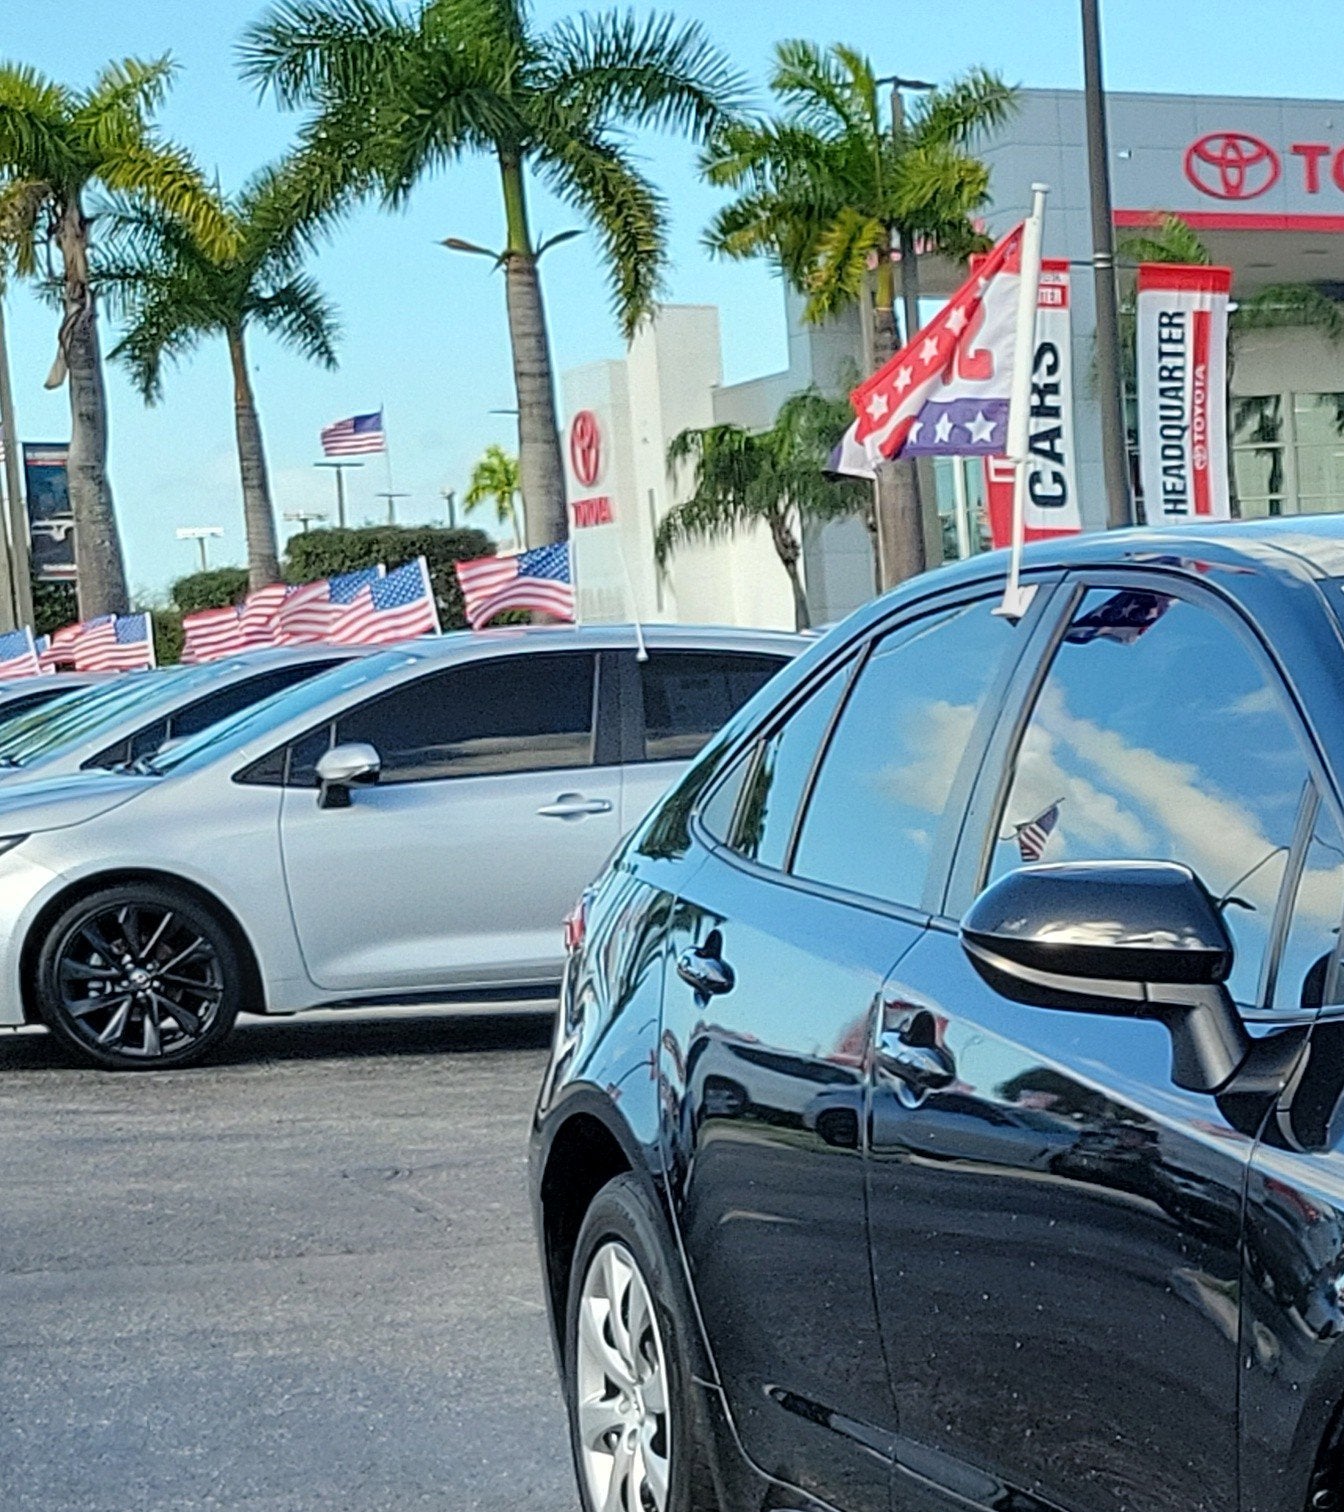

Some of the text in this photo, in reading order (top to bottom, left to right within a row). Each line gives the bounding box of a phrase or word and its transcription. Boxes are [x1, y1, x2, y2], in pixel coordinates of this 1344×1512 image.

[1027, 341, 1068, 508] CARS
[1158, 310, 1189, 516] HEADQUARTER
[1193, 364, 1208, 448] TOYOTA
